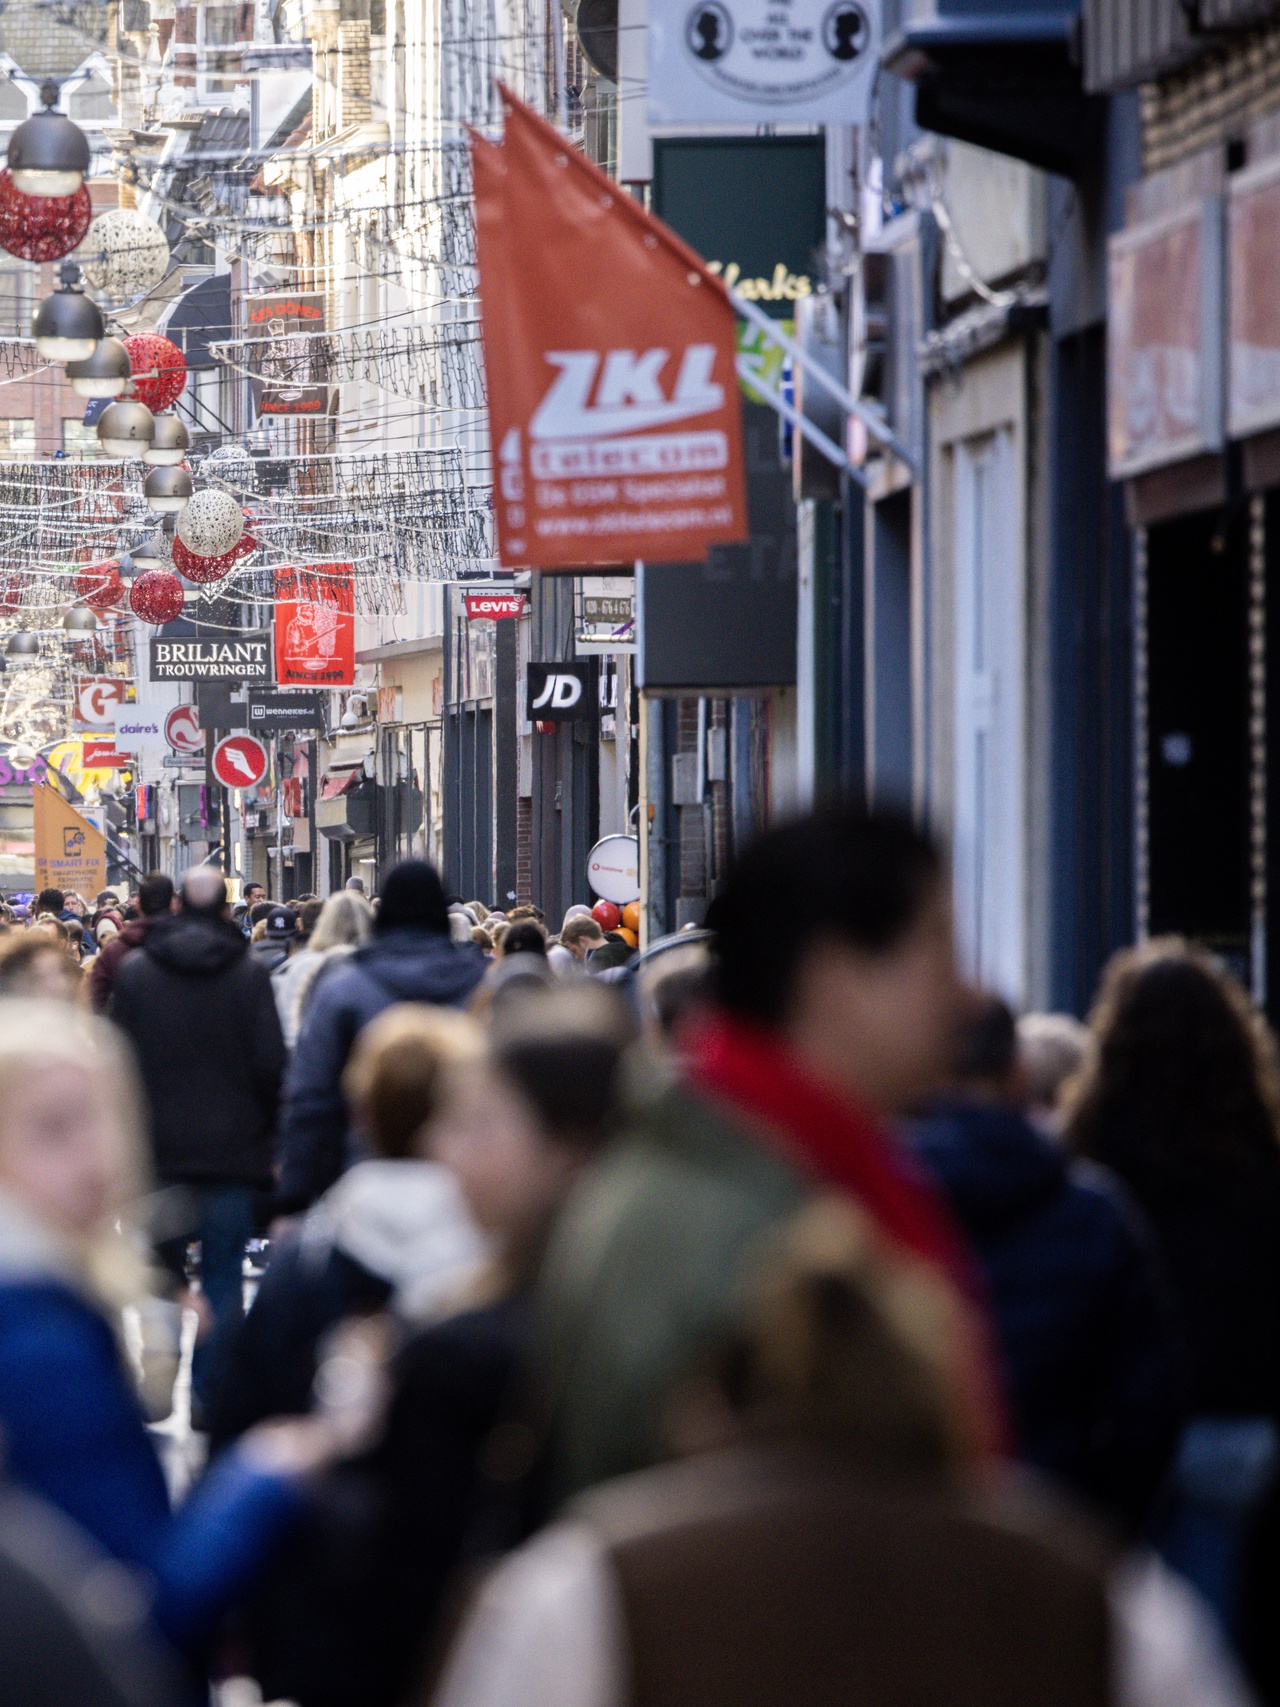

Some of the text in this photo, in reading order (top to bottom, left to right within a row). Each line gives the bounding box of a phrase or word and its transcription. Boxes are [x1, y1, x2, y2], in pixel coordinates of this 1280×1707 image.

[531, 342, 725, 438] ZKL
[293, 400, 320, 413] 1999
[156, 642, 267, 663] BRILJANT
[156, 664, 267, 677] TROUWRINGEN
[533, 674, 582, 709] JD
[120, 723, 158, 734] claire's
[50, 859, 82, 868] SMART
